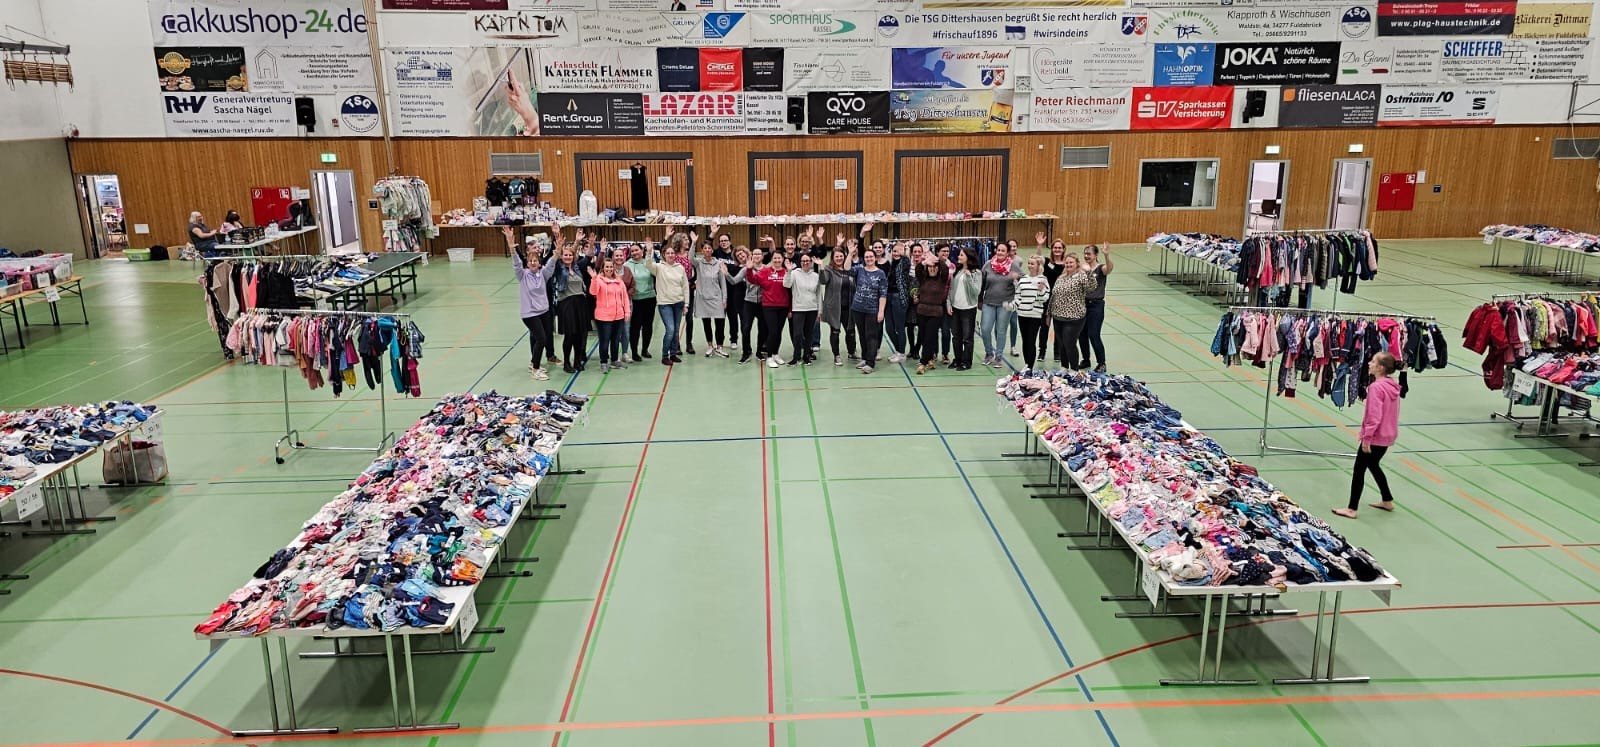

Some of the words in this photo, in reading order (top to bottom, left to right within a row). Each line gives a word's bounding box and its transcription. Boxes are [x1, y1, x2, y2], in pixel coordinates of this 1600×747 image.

[769, 13, 833, 25] SPORTHAUS
[904, 15, 920, 24] Die
[922, 14, 939, 23] TSG
[941, 12, 1003, 24] Dittershausen
[1005, 12, 1040, 26] begrüßt
[1042, 13, 1056, 22] Sie
[1057, 12, 1081, 21] recht
[1082, 12, 1117, 21] herzlich
[1227, 10, 1267, 21] Klapproth
[1279, 9, 1331, 19] Wischhusen
[1390, 19, 1501, 28] www.plag-haustechnik.de
[932, 30, 998, 40] #frischauf1896
[1033, 29, 1089, 38] #wirsindeins
[1284, 47, 1315, 56] Natürlich
[1443, 41, 1503, 58] SCHEFFER
[941, 51, 954, 60] Für
[981, 49, 1012, 63] Jugend
[1221, 47, 1273, 69] JOKA
[1283, 57, 1306, 65] schöne
[1308, 57, 1332, 65] Räume
[545, 65, 598, 77] KARSTEN
[600, 65, 653, 77] FLAMMER
[212, 95, 292, 105] Generalvertretung
[1298, 88, 1376, 101] fliesenALACA
[1385, 95, 1434, 104] Ostmann
[164, 96, 208, 114] R+V
[643, 94, 735, 115] LAZAR
[826, 97, 866, 114] QVO
[1035, 96, 1063, 106] Peter
[1065, 95, 1126, 106] Riechmann
[1177, 100, 1227, 110] Sparkassen
[213, 105, 244, 114] Sascha
[246, 105, 273, 115] Nägel
[1174, 109, 1226, 118] Versicherung
[543, 113, 603, 123] Rent.Group
[826, 117, 846, 126] CARE
[846, 117, 872, 125] HOUSE
